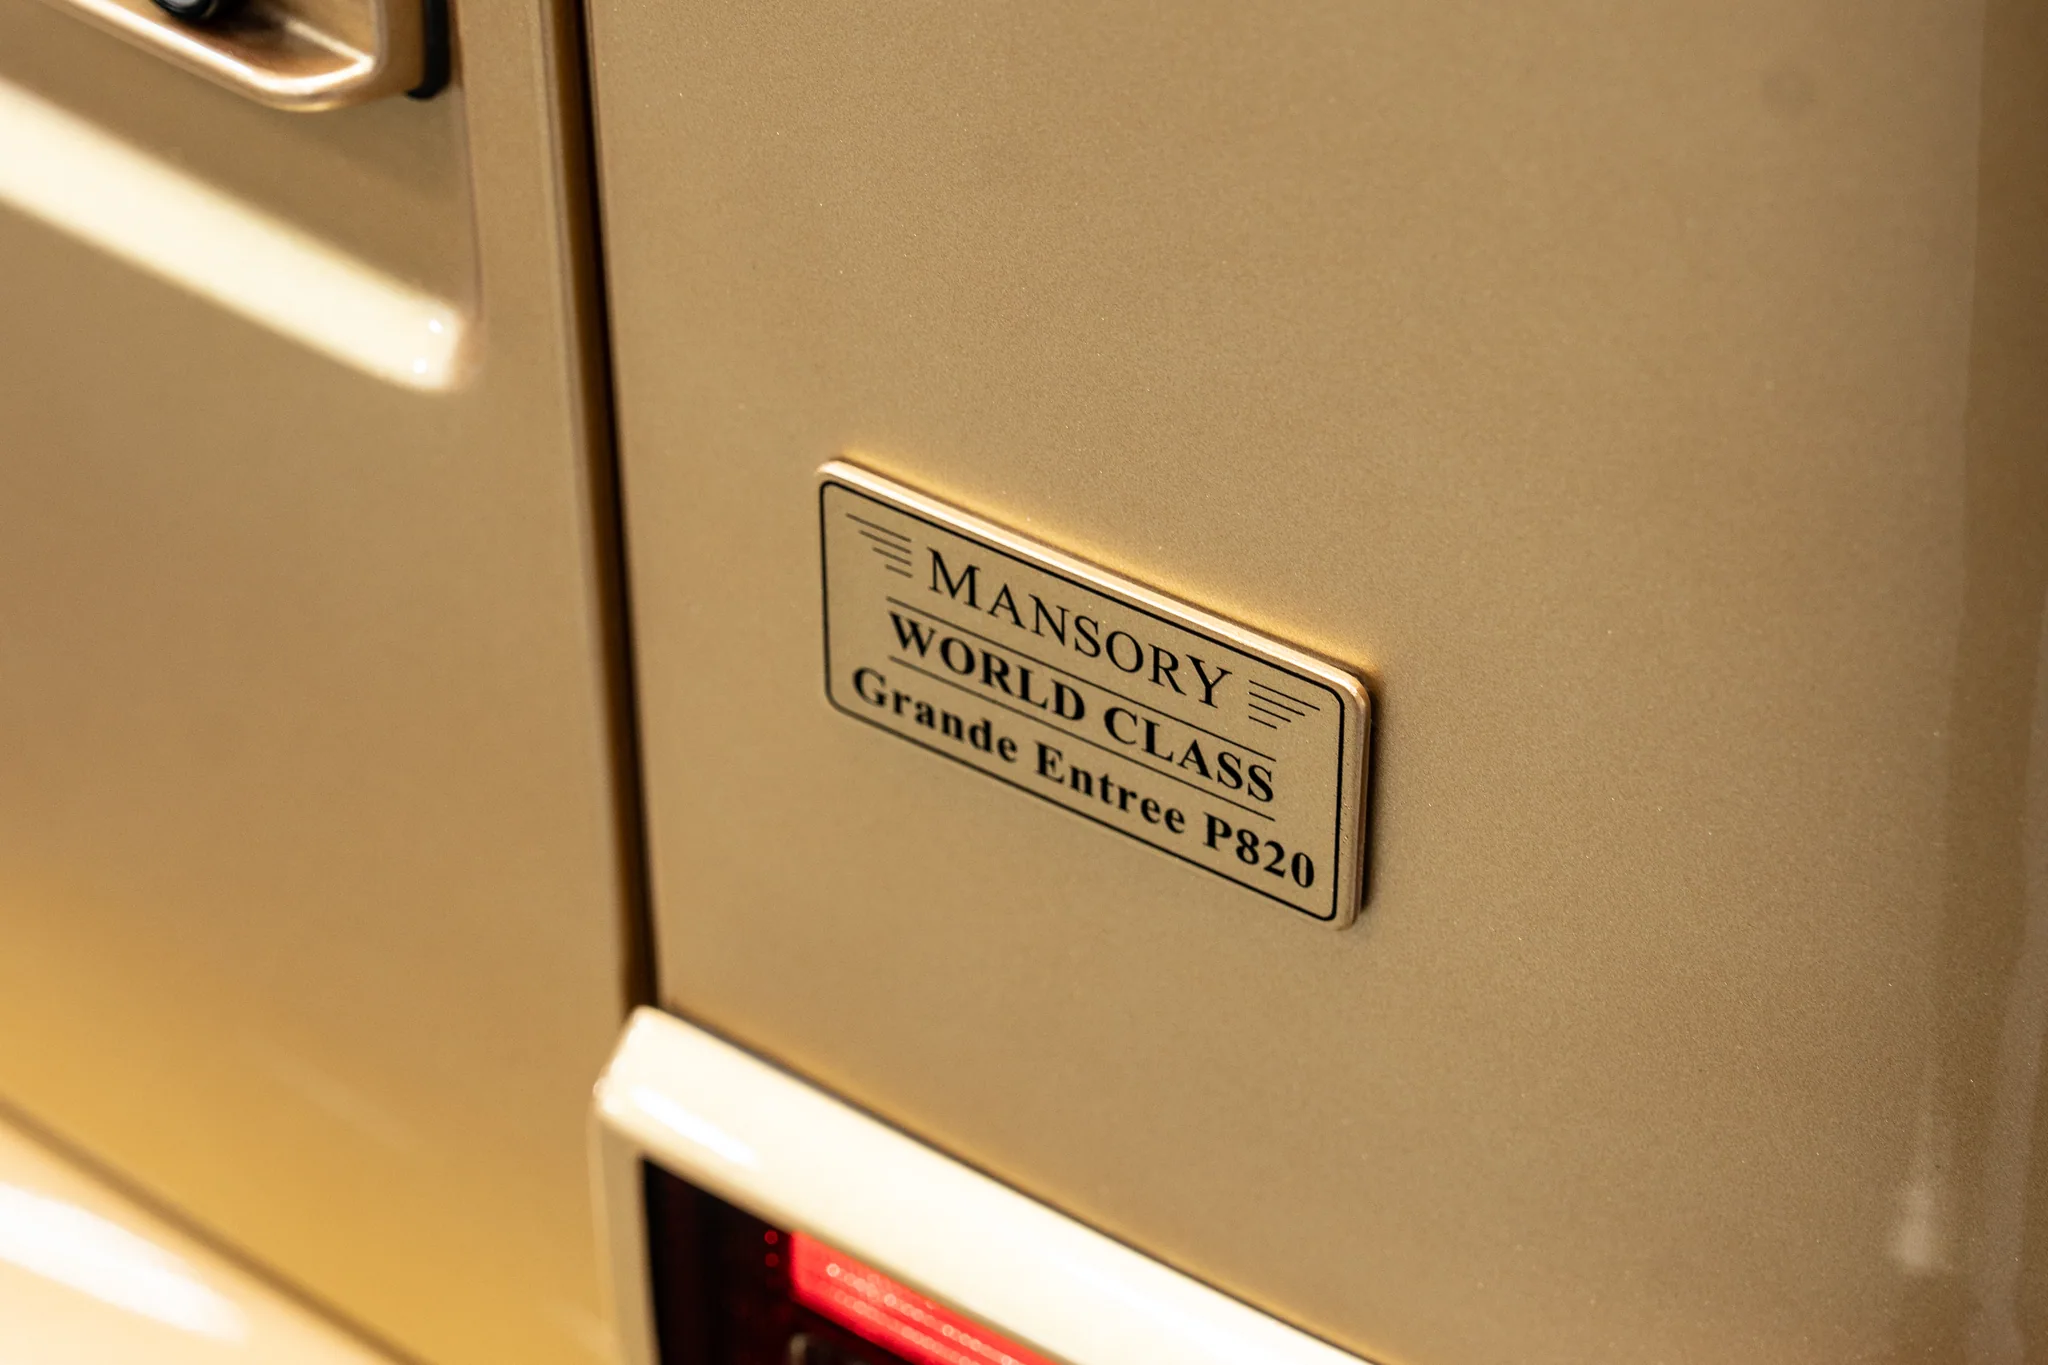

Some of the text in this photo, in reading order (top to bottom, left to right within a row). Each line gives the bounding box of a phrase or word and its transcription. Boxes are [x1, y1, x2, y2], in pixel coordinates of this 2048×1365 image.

[889, 611, 1275, 803] WORLD CLASS
[927, 546, 1233, 709] MANSORY
[853, 666, 1316, 889] Grande Entree P820
